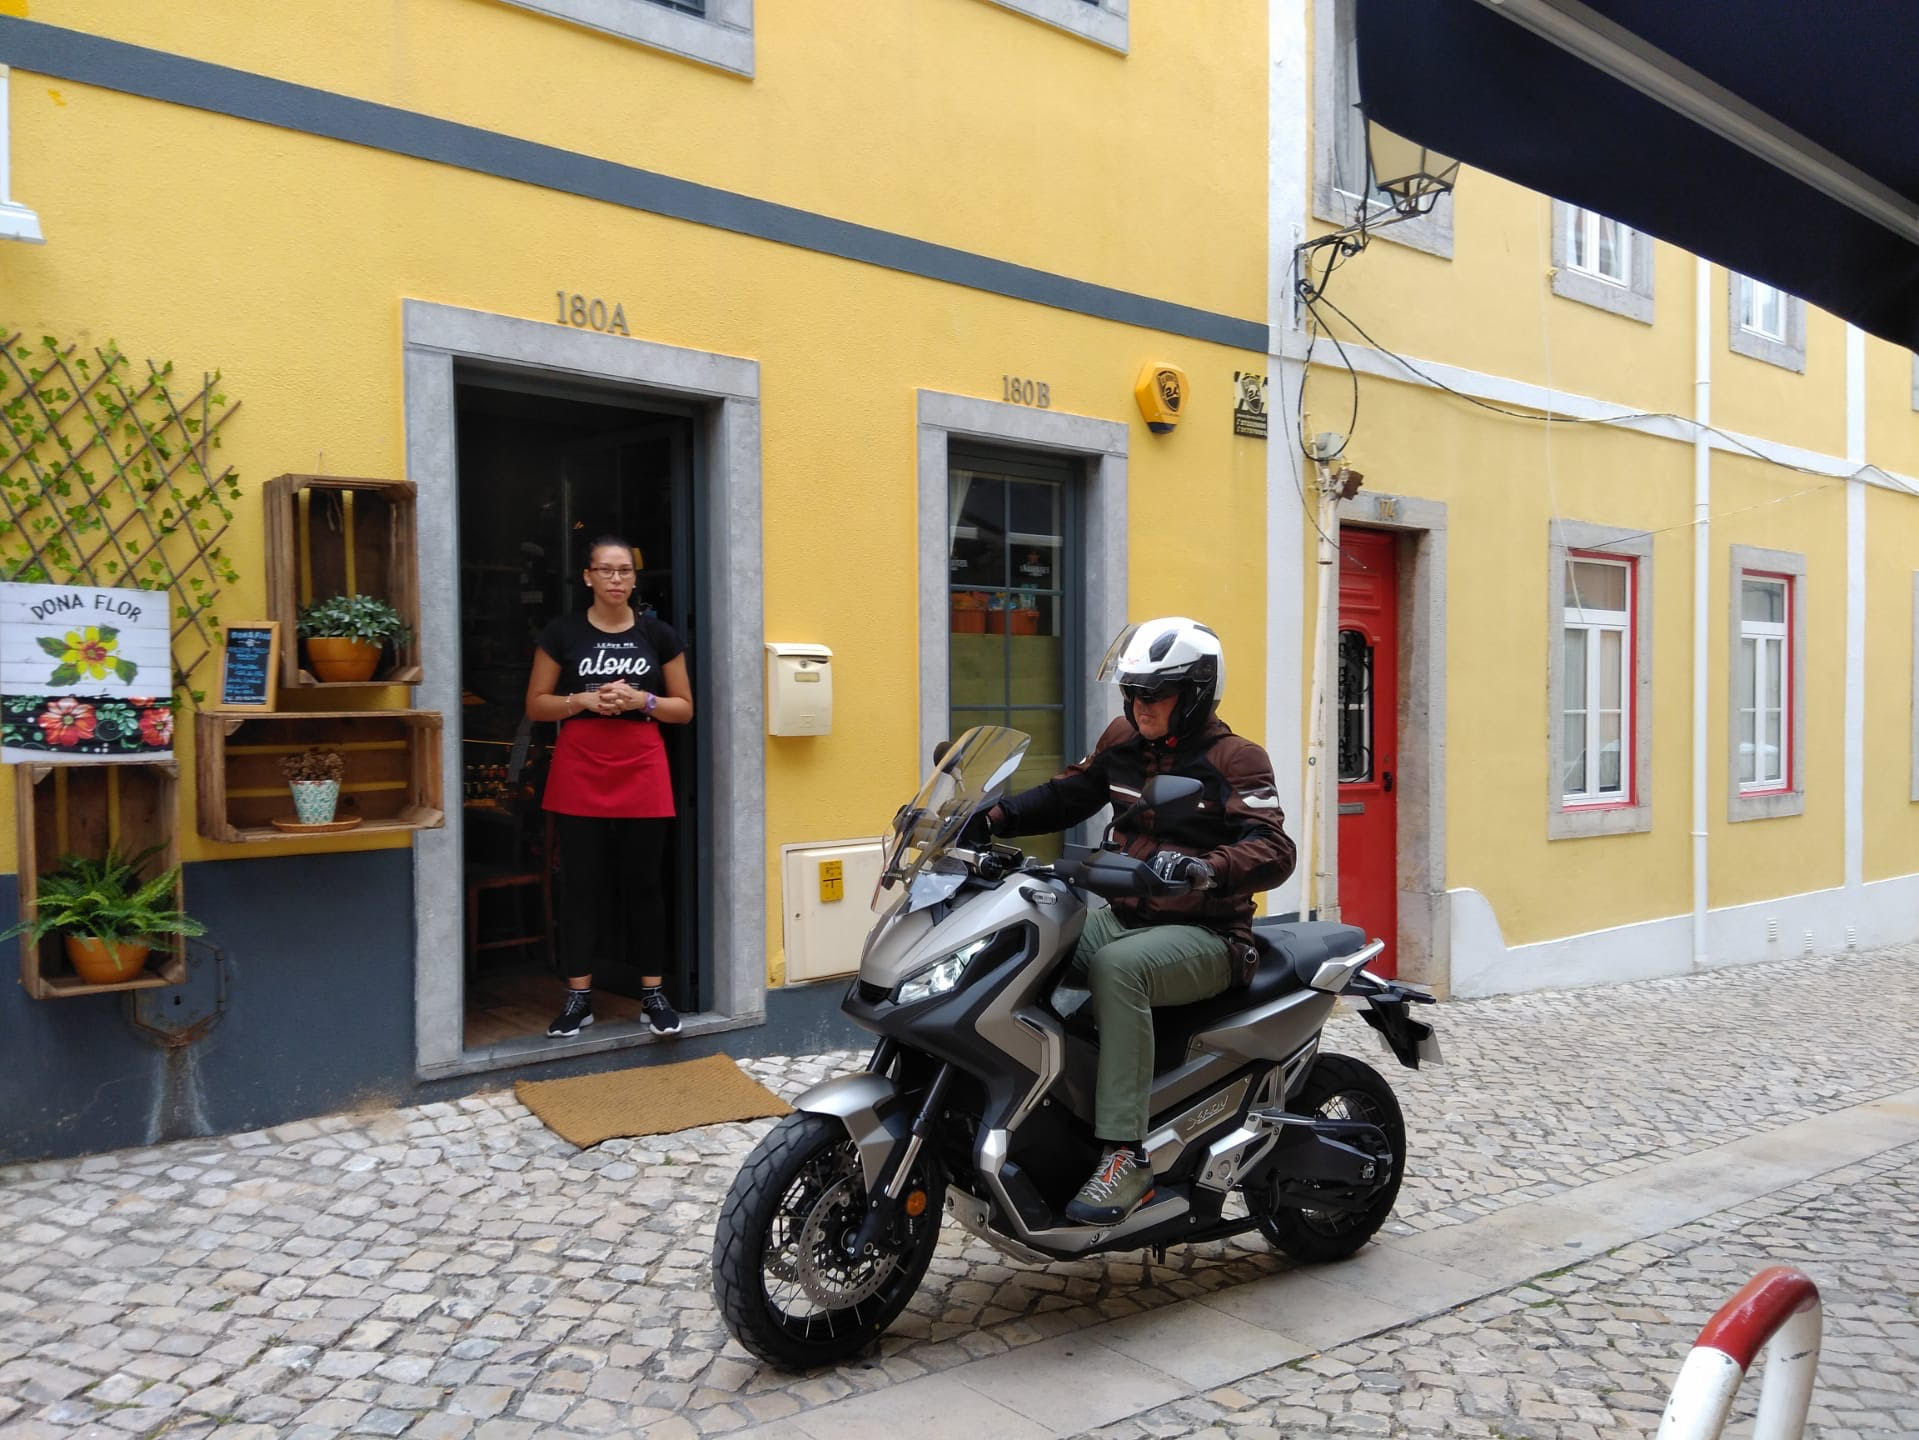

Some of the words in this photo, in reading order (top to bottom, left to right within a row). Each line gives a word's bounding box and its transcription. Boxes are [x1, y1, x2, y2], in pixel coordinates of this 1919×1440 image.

[557, 290, 630, 336] 180A
[1002, 375, 1050, 408] 180B
[30, 594, 84, 620] DONA
[94, 594, 142, 622] FLOR
[578, 649, 651, 676] alone
